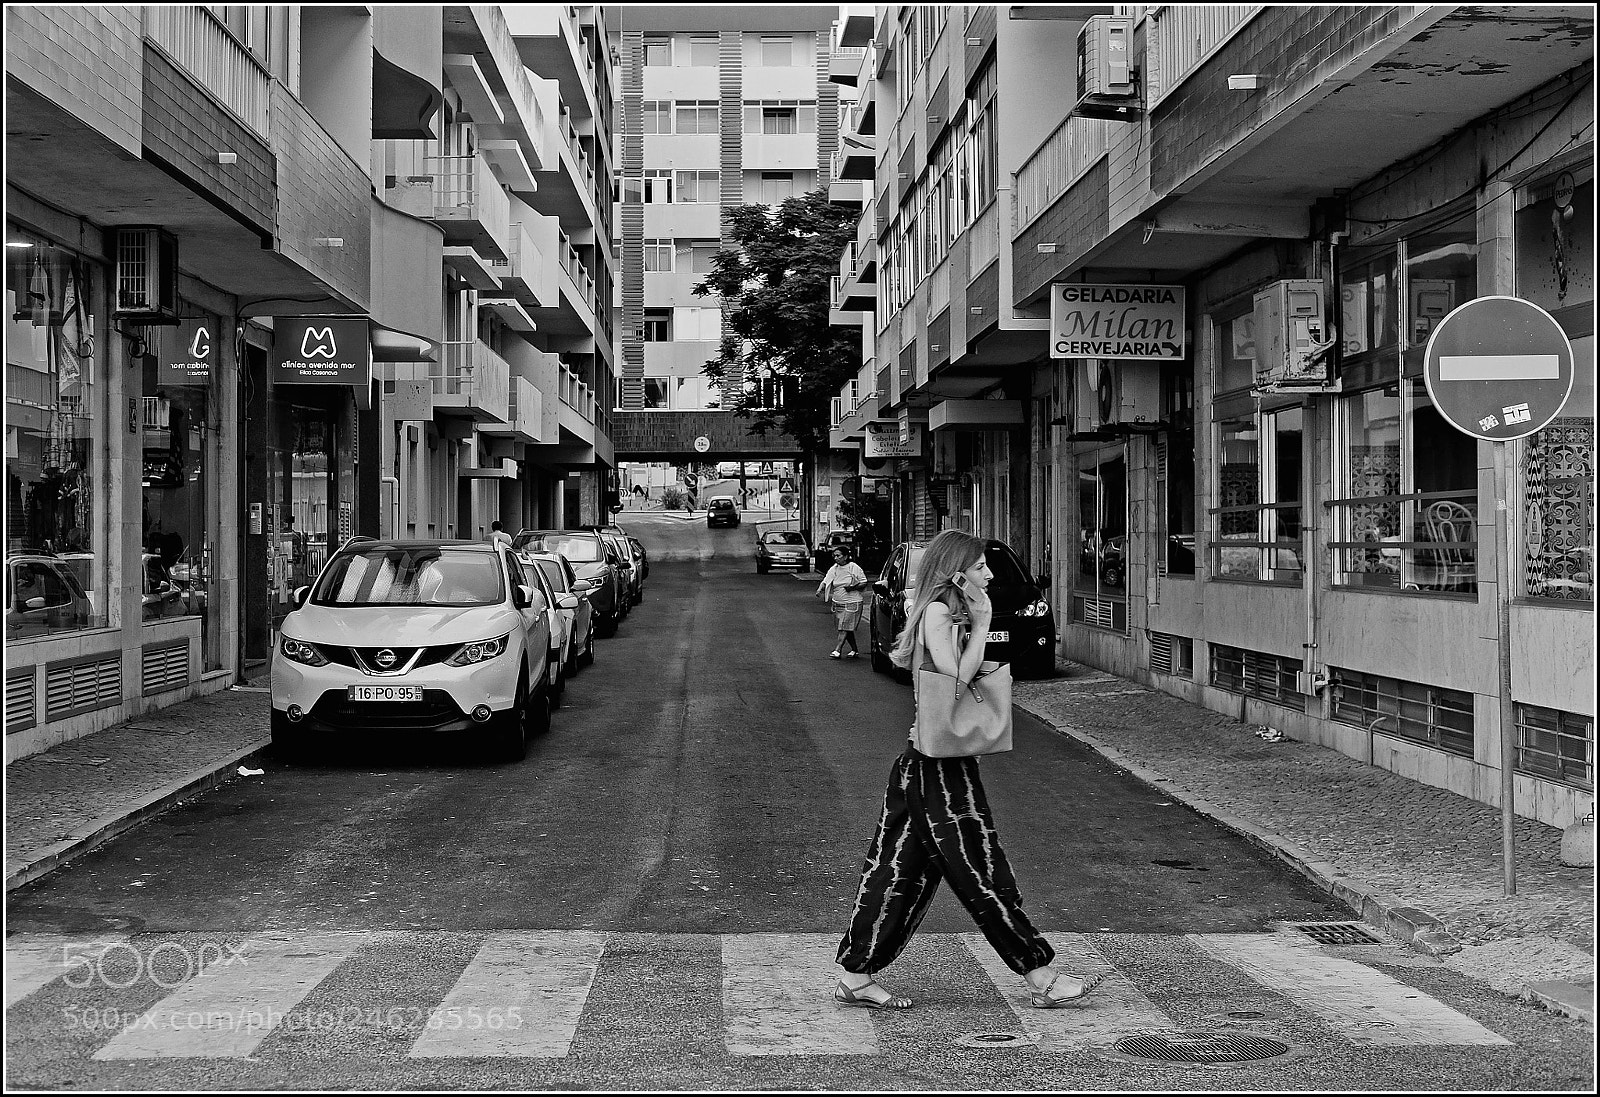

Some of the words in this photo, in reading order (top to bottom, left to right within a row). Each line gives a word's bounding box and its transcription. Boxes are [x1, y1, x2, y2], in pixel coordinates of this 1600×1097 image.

[1062, 287, 1176, 304] GELADARIA
[1060, 307, 1177, 339] Milan
[1055, 341, 1162, 355] CERVEJARIA
